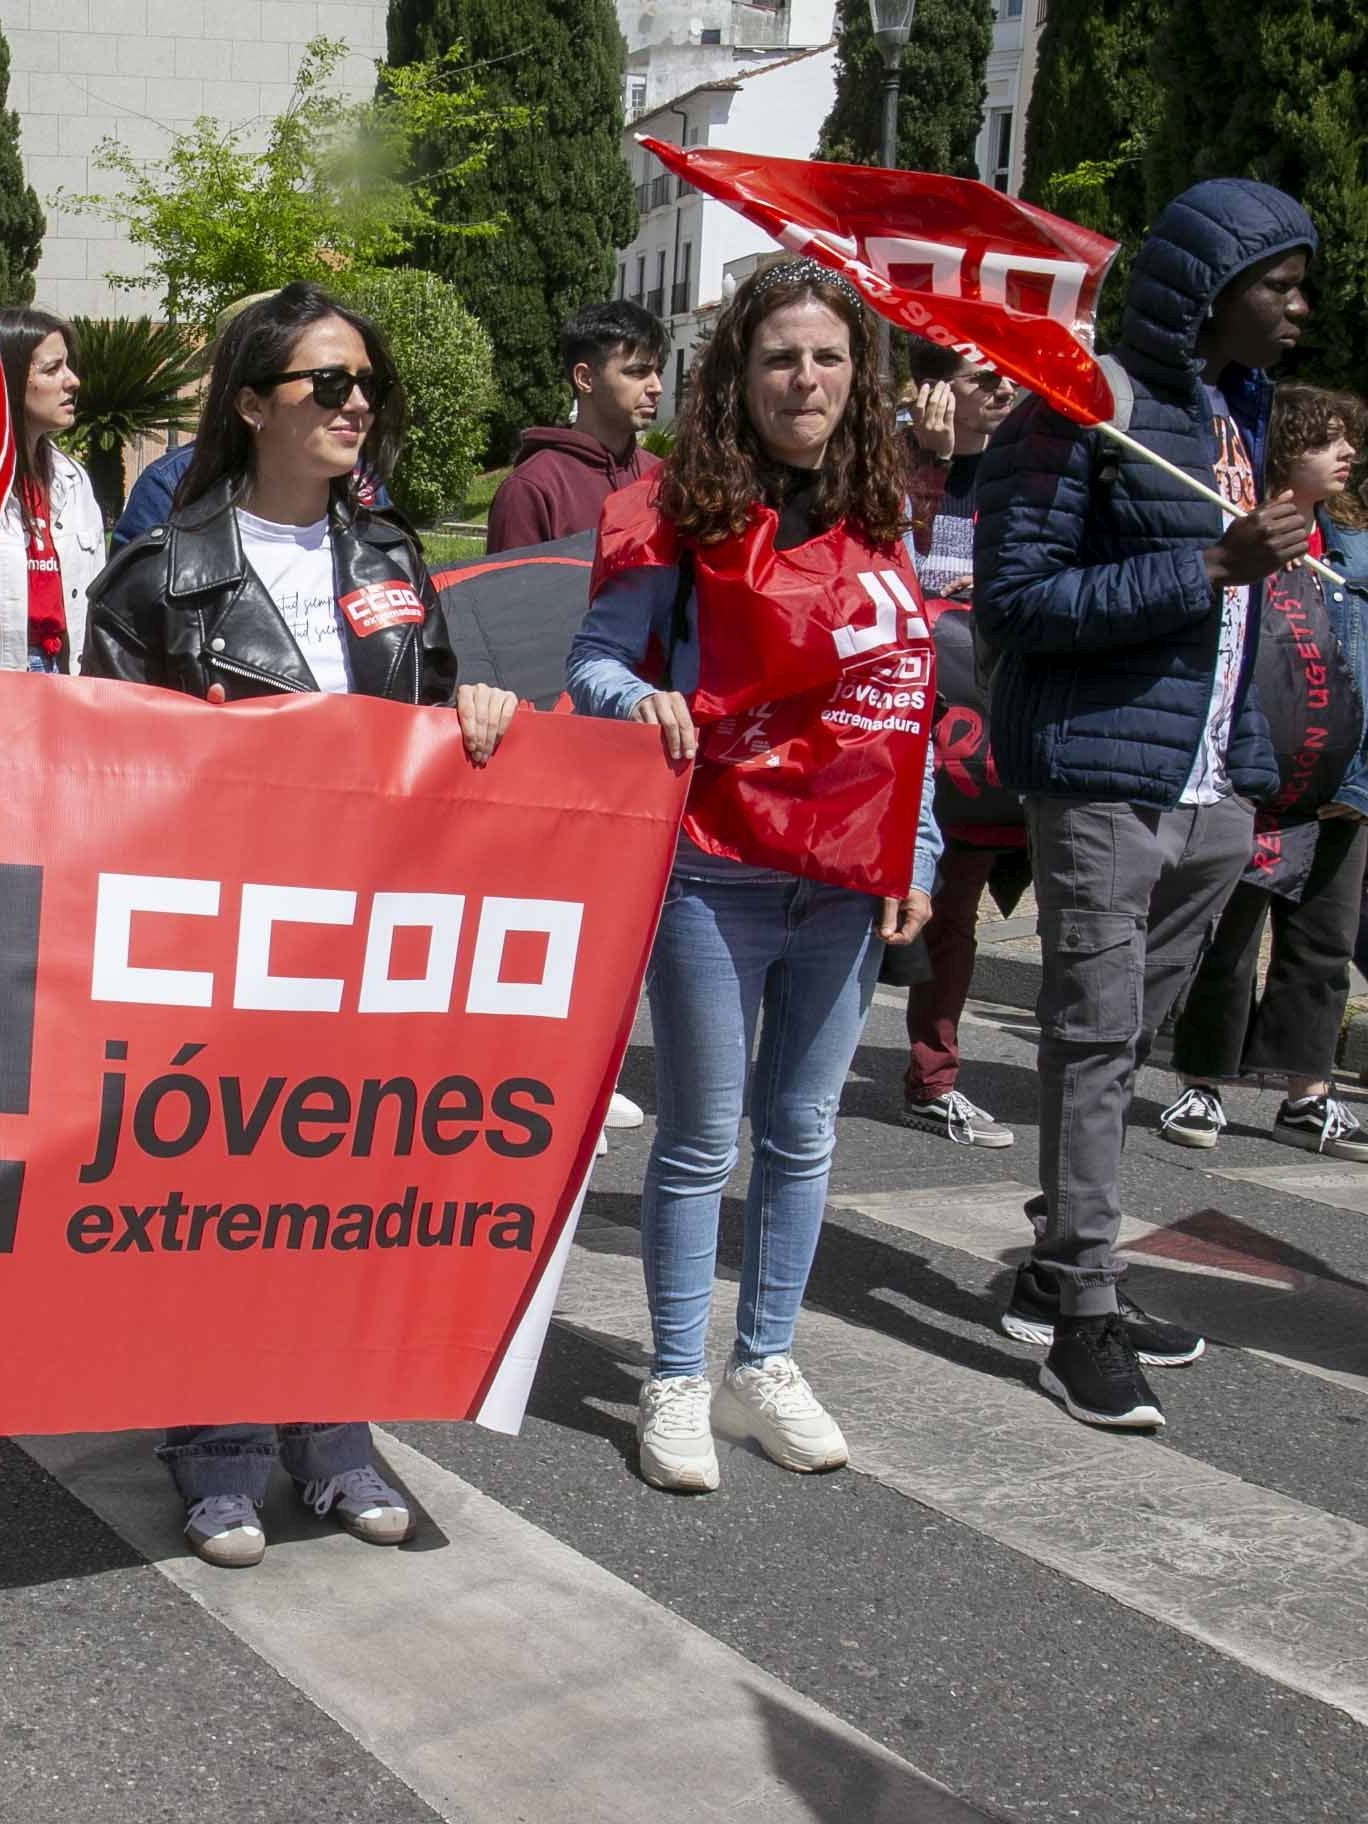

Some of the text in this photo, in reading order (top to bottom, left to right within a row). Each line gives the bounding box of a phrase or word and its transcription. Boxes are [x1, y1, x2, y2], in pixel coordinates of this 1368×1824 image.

[346, 589, 421, 621] CCOO
[821, 709, 921, 735] extremadura
[91, 872, 585, 1019] CCOO
[78, 1039, 555, 1184] jóvenes
[65, 1186, 536, 1254] extremadura
